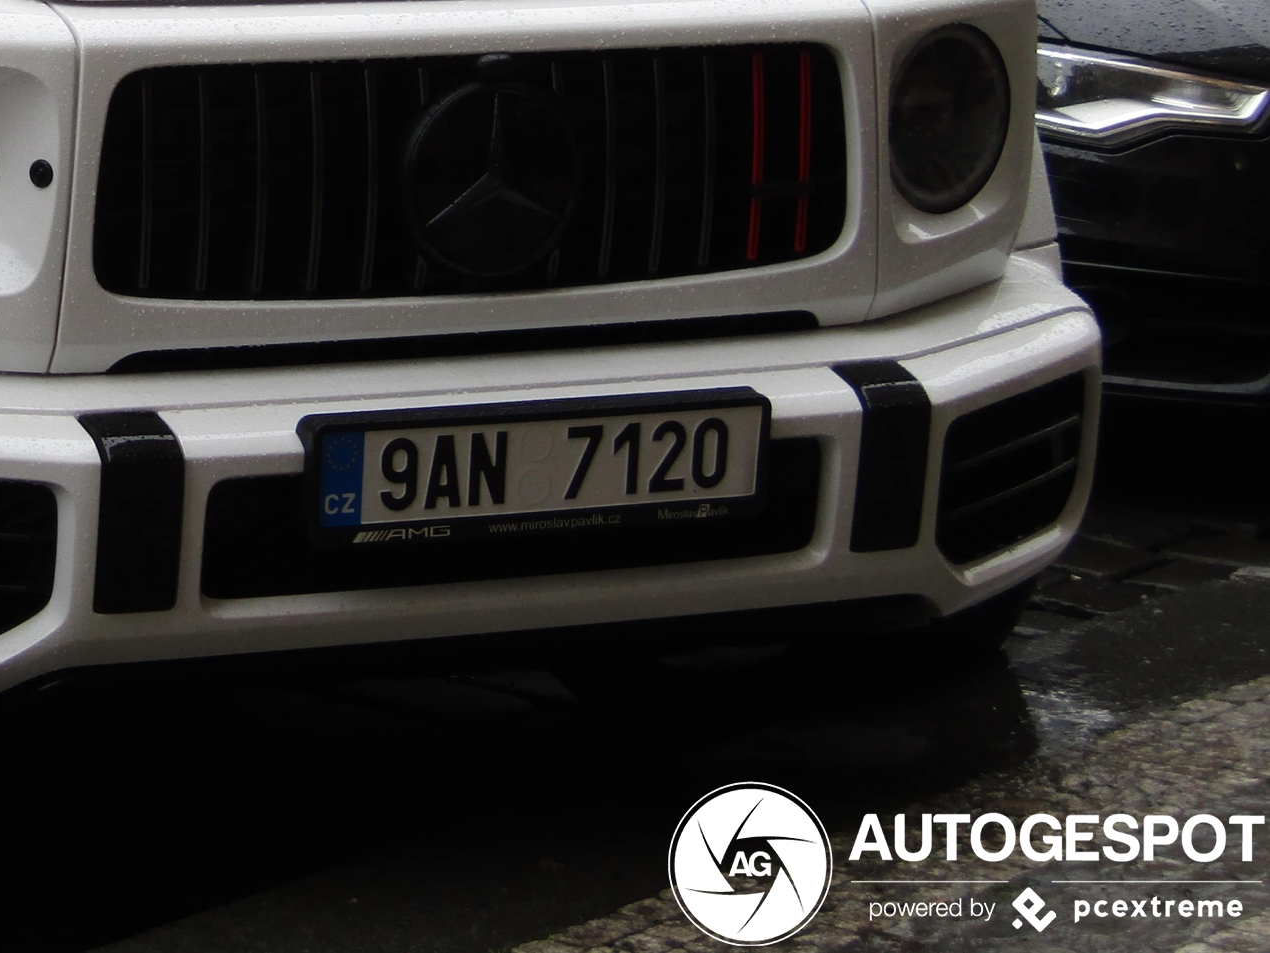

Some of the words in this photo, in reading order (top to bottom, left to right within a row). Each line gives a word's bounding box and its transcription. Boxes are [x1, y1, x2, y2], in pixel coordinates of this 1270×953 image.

[381, 431, 508, 511] 9AN
[564, 417, 728, 500] 7120
[324, 493, 356, 515] CZ
[488, 513, 622, 534] www.miroslavpavlik.cz
